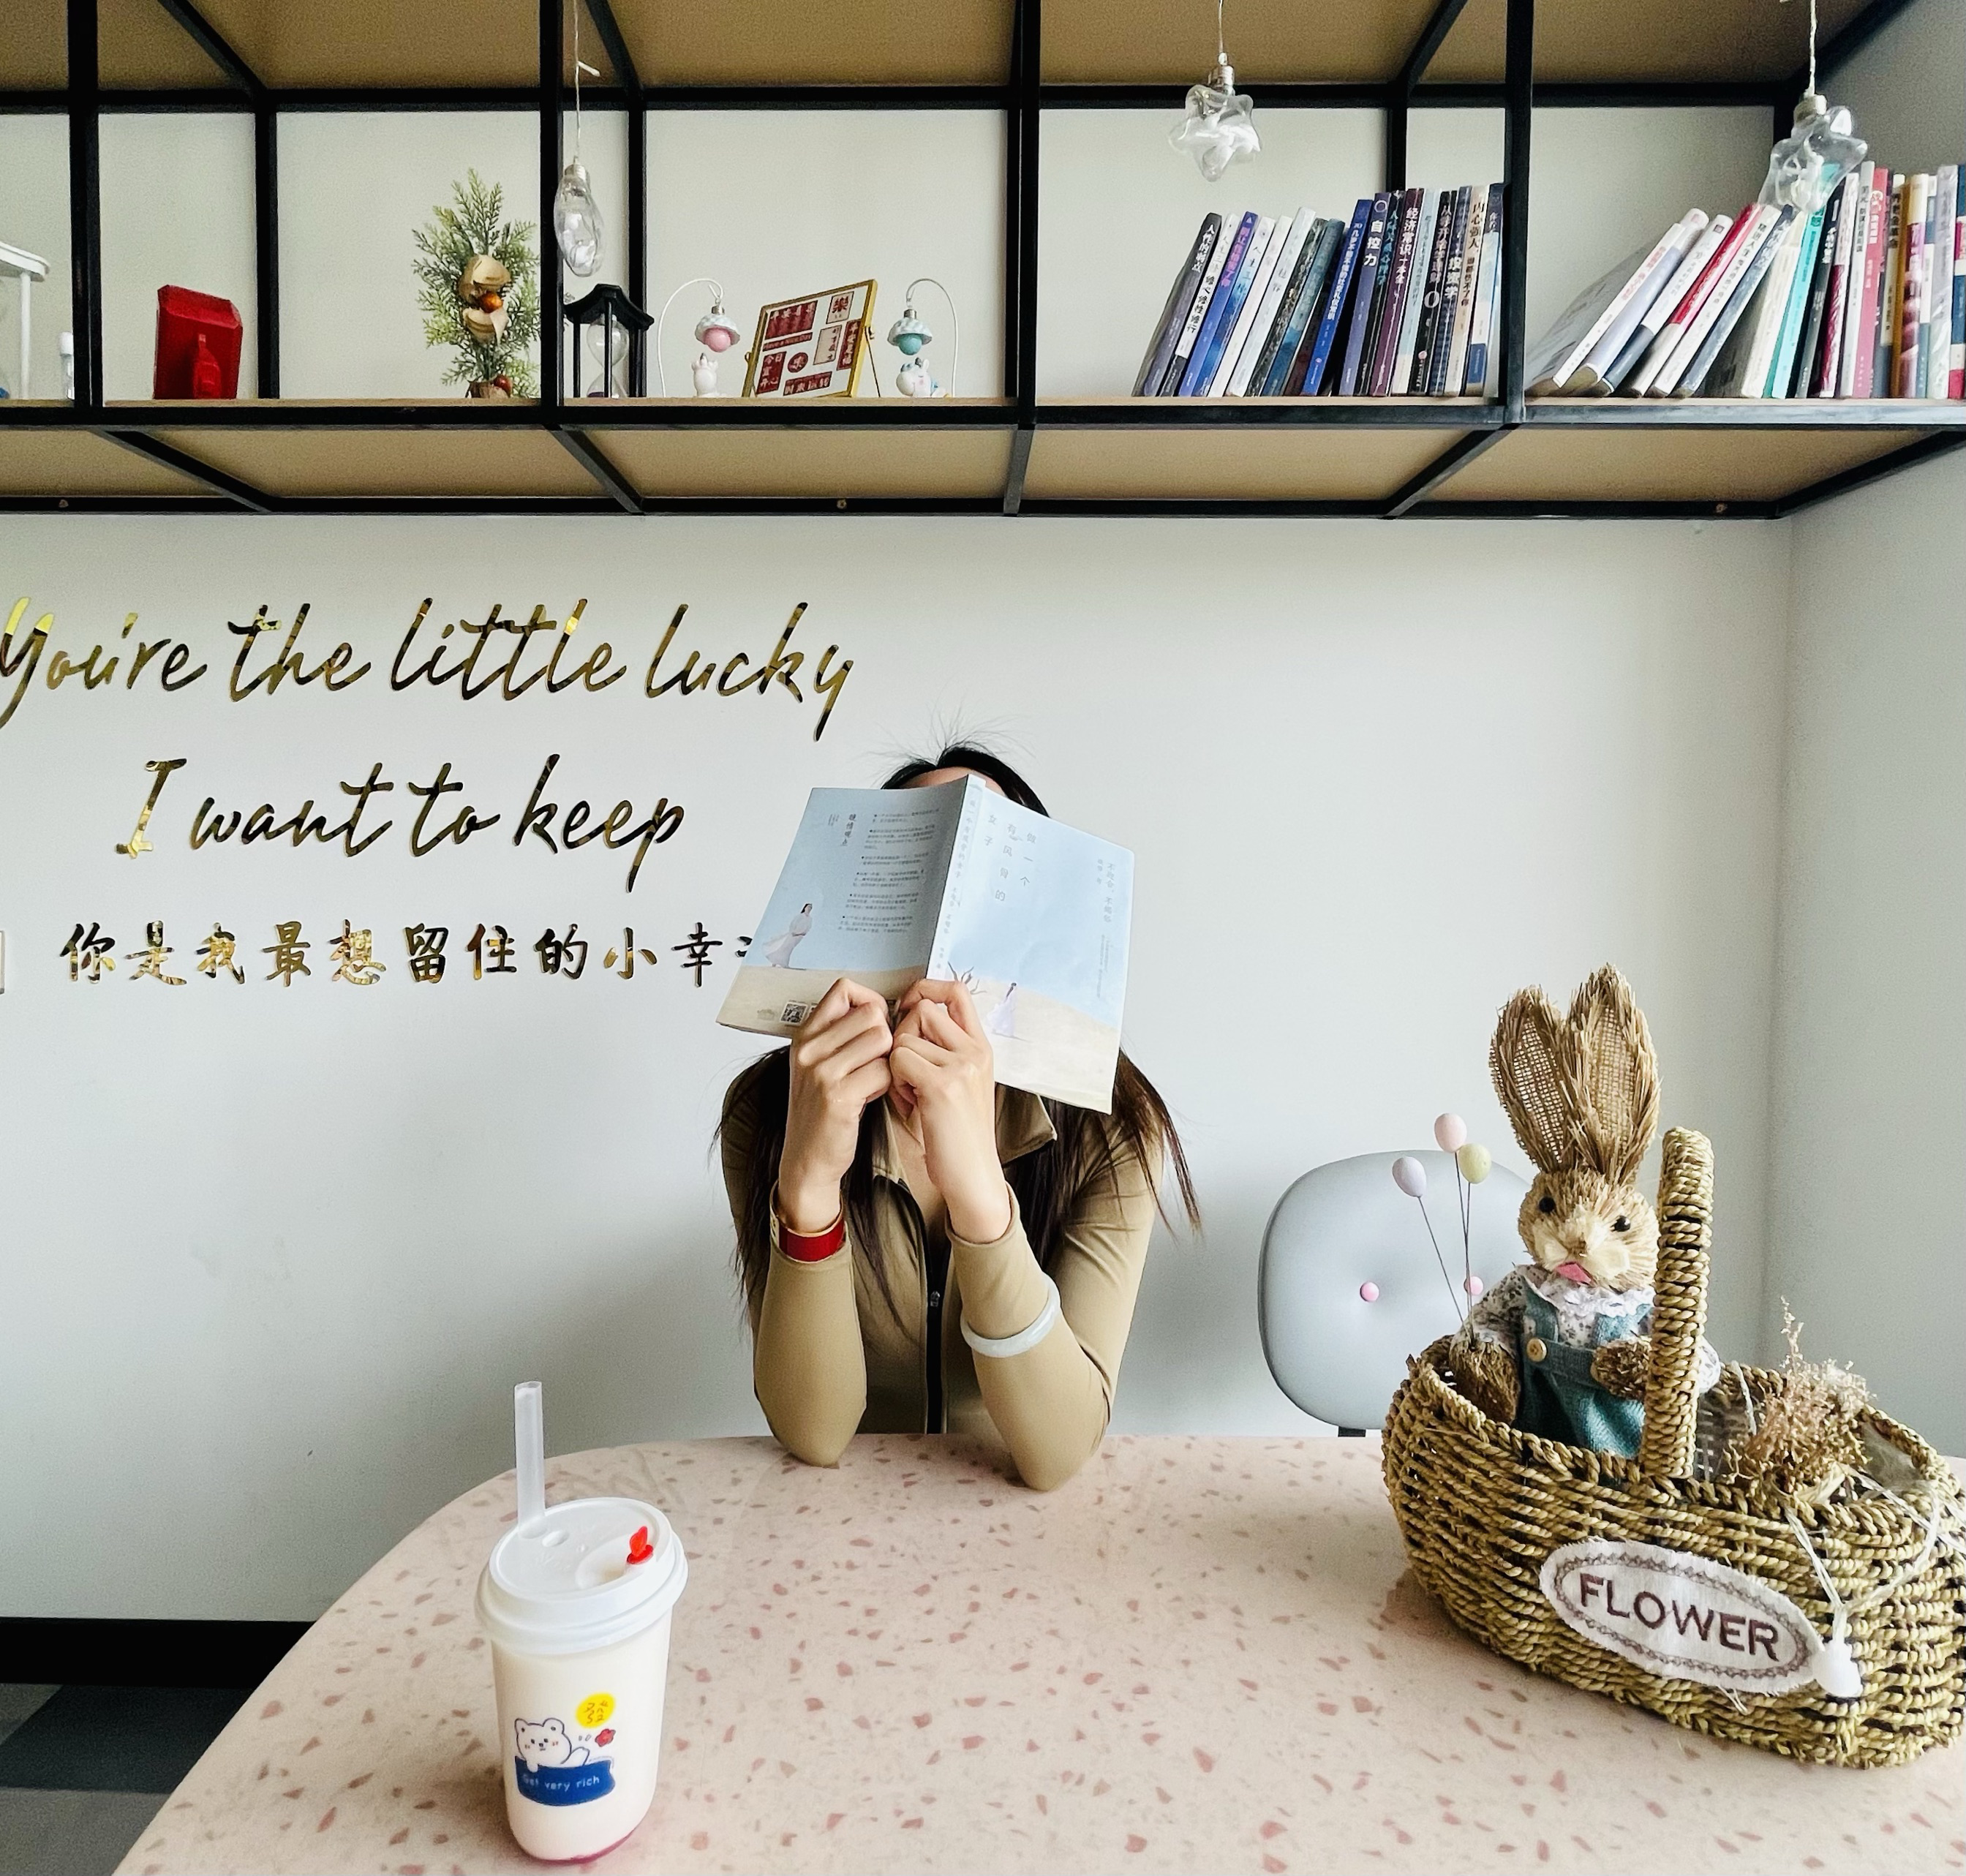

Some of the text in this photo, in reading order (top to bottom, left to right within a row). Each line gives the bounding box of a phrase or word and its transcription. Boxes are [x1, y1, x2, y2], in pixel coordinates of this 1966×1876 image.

[1363, 220, 1384, 267] 自控力
[227, 603, 372, 702] the
[390, 597, 627, 701] little
[644, 600, 854, 742] lucky
[114, 753, 686, 893] I want to keep
[983, 814, 998, 846] 女子
[995, 823, 1017, 902] 有风骨的
[1020, 832, 1037, 886] 做一个
[59, 918, 753, 987] 你是我最想留住的小幸
[1579, 1572, 1779, 1662] FLOWER
[544, 1779, 571, 1793] very
[576, 1775, 600, 1788] rich
